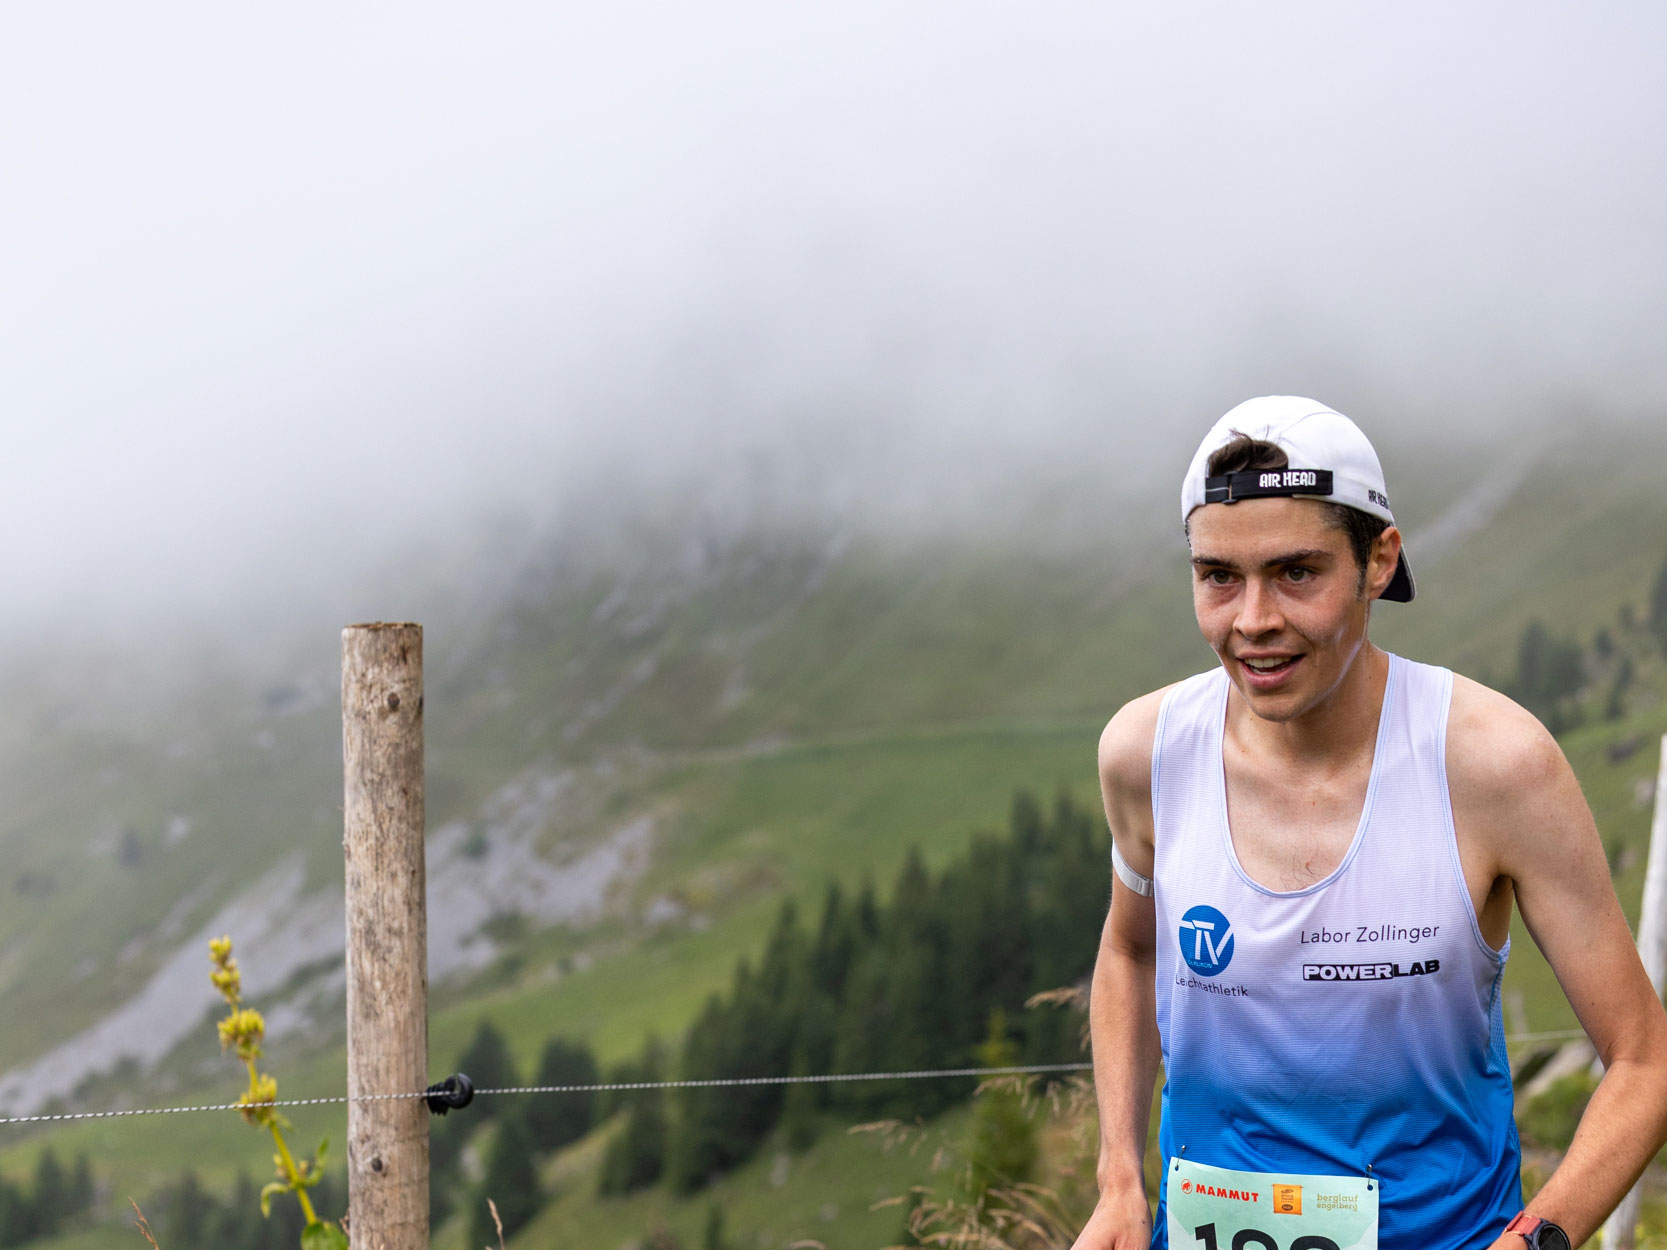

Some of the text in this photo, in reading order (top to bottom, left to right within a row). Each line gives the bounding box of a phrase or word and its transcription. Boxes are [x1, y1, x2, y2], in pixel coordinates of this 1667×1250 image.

[1259, 471, 1317, 488] AIR HEAD
[1301, 925, 1440, 944] Labor Zollinger
[1302, 959, 1440, 981] POWERLAB
[1175, 974, 1249, 997] Leichtathletik
[1196, 1183, 1259, 1203] MAMMUT
[1316, 1193, 1358, 1205] berglauf
[1316, 1201, 1358, 1211] engelberg
